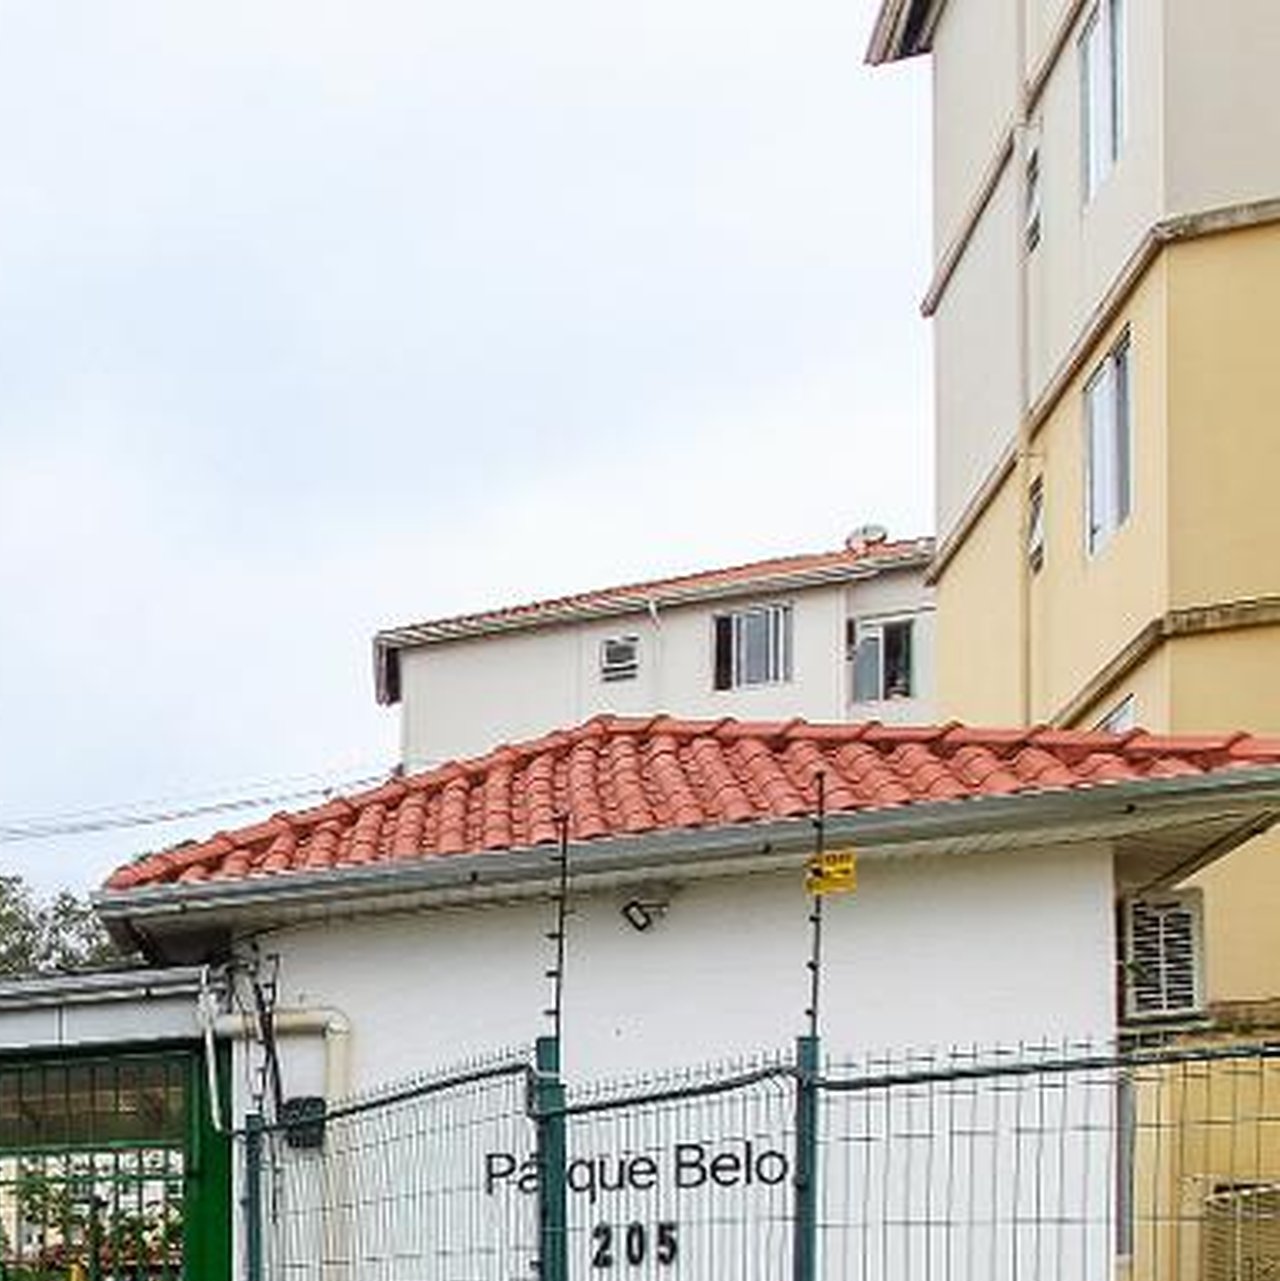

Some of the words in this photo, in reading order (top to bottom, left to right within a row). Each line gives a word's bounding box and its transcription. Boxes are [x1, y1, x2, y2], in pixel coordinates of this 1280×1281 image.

[485, 1153, 658, 1204] Paque
[674, 1141, 790, 1189] Belo
[592, 1221, 679, 1269] 205
